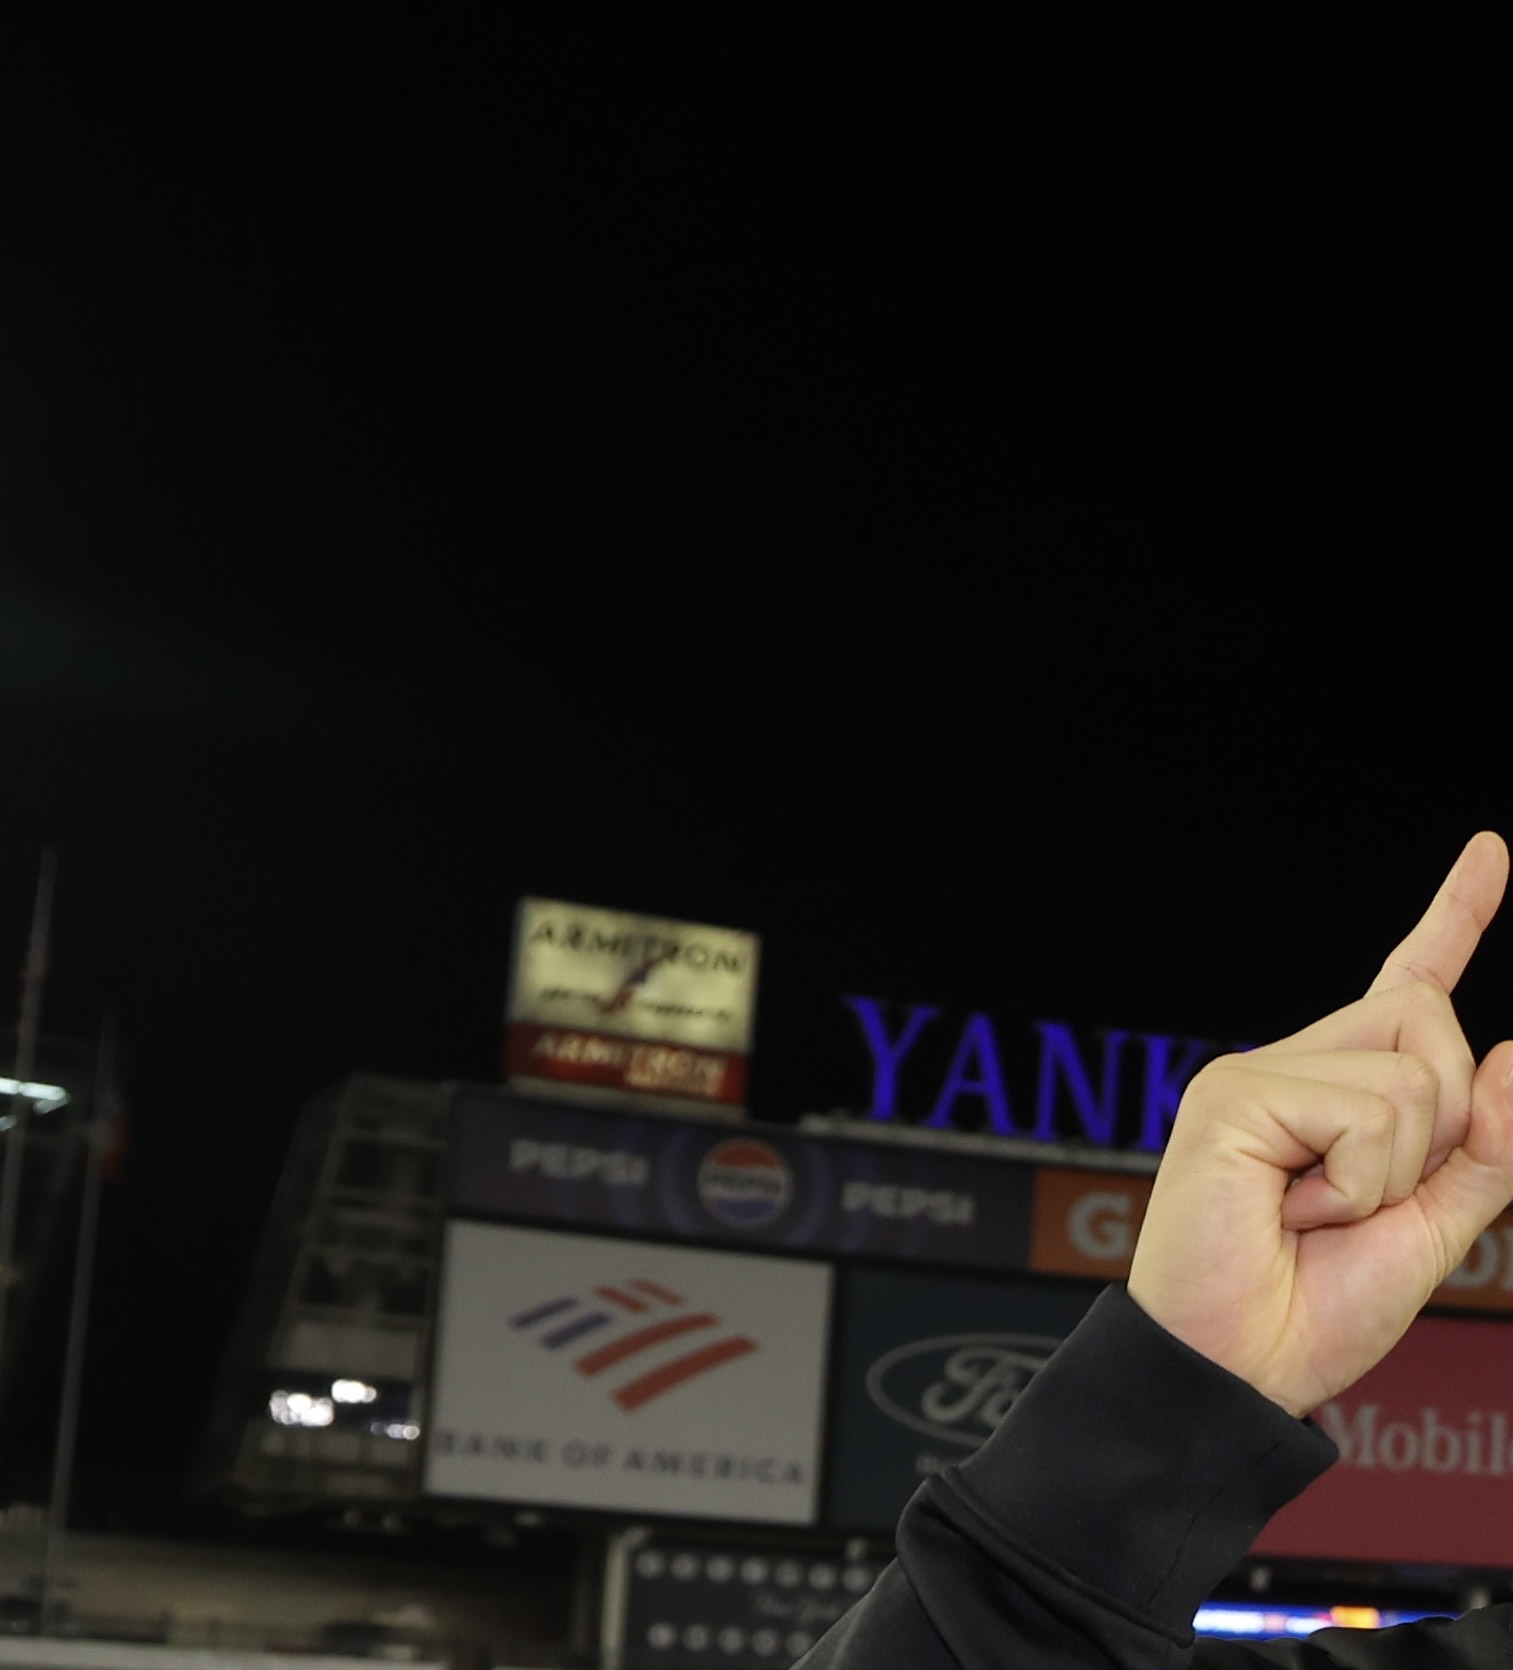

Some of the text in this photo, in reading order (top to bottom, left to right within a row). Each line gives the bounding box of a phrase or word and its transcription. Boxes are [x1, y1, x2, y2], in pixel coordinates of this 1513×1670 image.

[509, 1138, 650, 1188] PEPSI
[841, 1180, 976, 1226] PEPSI
[433, 1429, 805, 1485] BANK OF AMERICA
